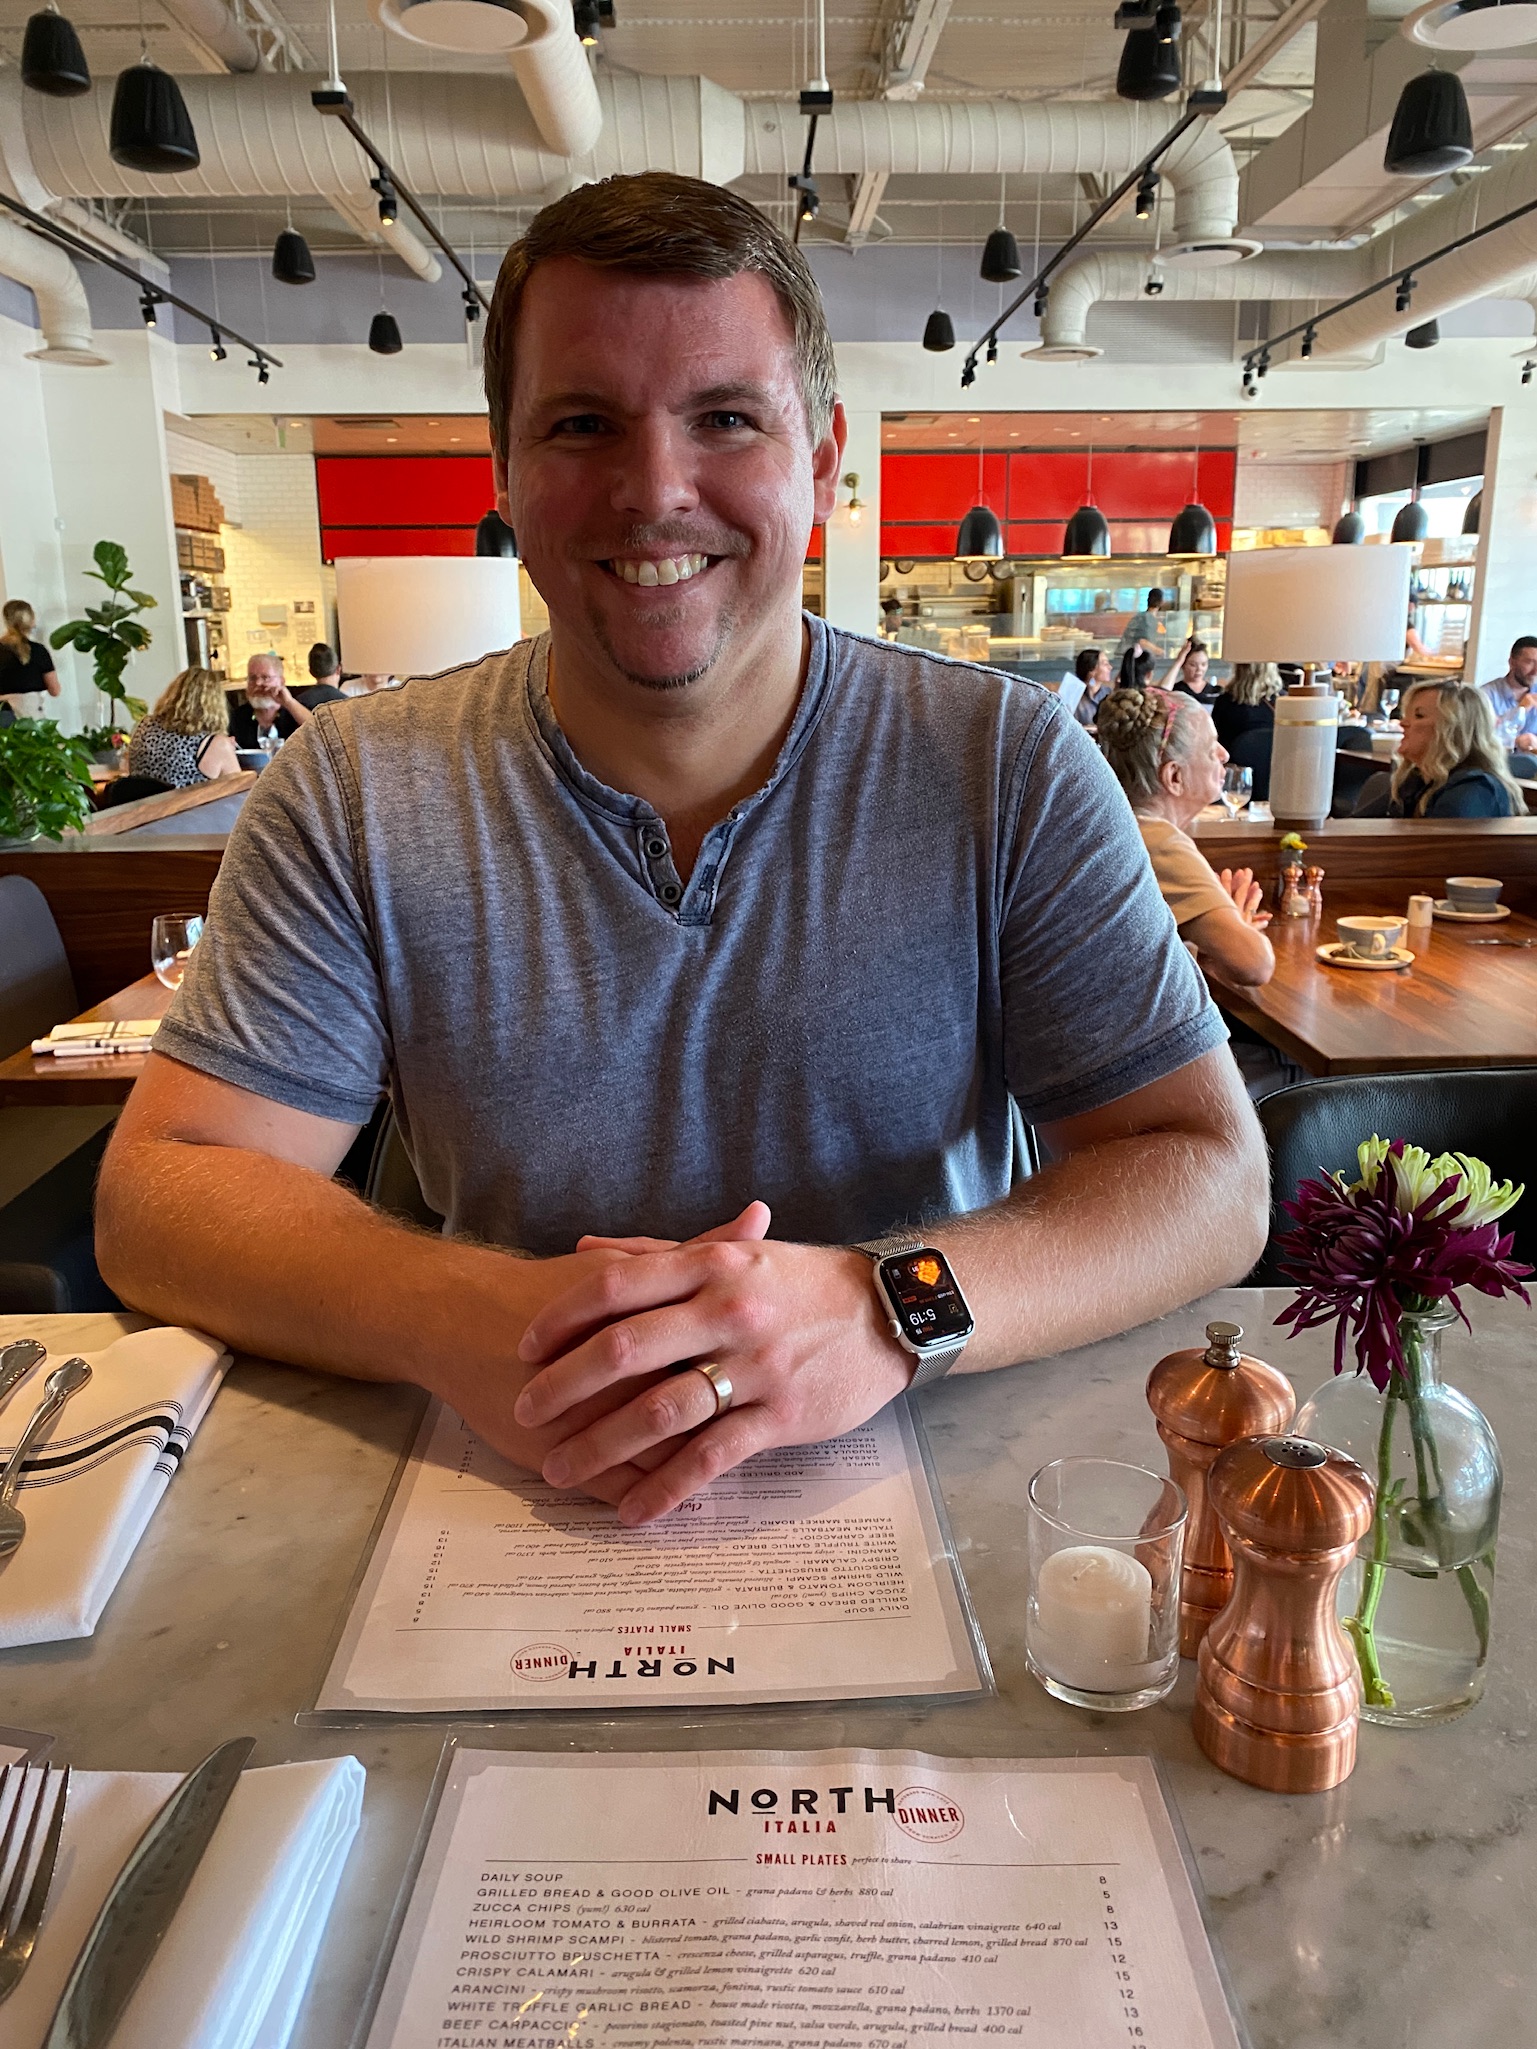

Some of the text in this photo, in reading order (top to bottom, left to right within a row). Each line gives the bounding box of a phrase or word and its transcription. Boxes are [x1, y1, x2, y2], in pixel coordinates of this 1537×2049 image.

[909, 1308, 937, 1326] 5:19
[793, 1526, 851, 1534] MEATBALLS
[862, 1555, 899, 1563] CRISPY
[759, 1564, 901, 1575] PROSCIUTTO BRUSCHETTA
[787, 1575, 826, 1583] SCAMPI
[832, 1573, 871, 1581] SHRIMP
[832, 1590, 864, 1598] CHIPS
[771, 1601, 803, 1609] GOOD
[820, 1599, 856, 1607] BREAD
[880, 1604, 909, 1612] DAILY
[617, 1624, 691, 1634] SMALL PLATES
[624, 1646, 684, 1656] ITALIA
[515, 1655, 568, 1670] DINNER
[568, 1657, 735, 1678] NORTH
[708, 1787, 896, 1815] NORTH
[898, 1807, 960, 1824] DINNER
[764, 1820, 836, 1833] ITALIA
[756, 1854, 797, 1865] SMALL
[802, 1854, 847, 1865] PLATES
[852, 1856, 879, 1865] perfect
[890, 1856, 911, 1864] share
[1100, 1876, 1106, 1884] 8
[477, 1888, 537, 1897] GRILLED
[543, 1889, 590, 1897] BREAD
[611, 1889, 653, 1897] GOOD
[660, 1888, 700, 1897] OLIVE
[776, 1888, 812, 1897] padano
[880, 1888, 893, 1896] cal
[1103, 1890, 1110, 1898] 5
[473, 1903, 520, 1912] ZUCCA
[527, 1904, 570, 1912] CHIPS
[577, 1905, 609, 1915] (yum!)
[636, 1904, 651, 1912] cal
[1107, 1905, 1114, 1913] 8
[469, 1919, 545, 1928] HEIRLOOM
[553, 1919, 610, 1928] TOMATO
[617, 1920, 624, 1928] &
[632, 1919, 695, 1928] BURRATA
[713, 1916, 744, 1928] grilled
[747, 1917, 787, 1926] ciabatta,
[791, 1918, 830, 1928] arugula,
[836, 1918, 867, 1926] shaved
[870, 1919, 884, 1927] red
[920, 1921, 963, 1929] calabrian
[967, 1924, 1019, 1933] vinaigrette
[1048, 1922, 1061, 1930] cal
[1104, 1921, 1118, 1930] 13
[466, 1935, 500, 1943] WILD
[506, 1935, 563, 1943] SHRIMP
[569, 1936, 623, 1944] SCAMPI
[642, 1935, 682, 1944] blistered
[684, 1934, 719, 1943] tomato,
[722, 1933, 750, 1944] grana
[752, 1932, 791, 1943] padano,
[794, 1933, 821, 1944] garlic
[824, 1934, 852, 1945] confit,
[880, 1935, 909, 1944] butter,
[913, 1936, 948, 1945] charred
[952, 1938, 982, 1947] lemon,
[987, 1938, 1017, 1949] grilled
[1020, 1938, 1047, 1946] bread
[1108, 1937, 1122, 1946] 15
[460, 1951, 555, 1960] PROSCIUTTO
[562, 1952, 659, 1960] BRUSCHETTA
[726, 1948, 755, 1957] cheese,
[759, 1949, 792, 1959] grilled
[795, 1952, 846, 1962] asparagus,
[850, 1951, 883, 1963] truffle,
[886, 1954, 916, 1964] grana
[919, 1954, 956, 1964] padano
[1112, 1954, 1126, 1963] 12
[456, 1965, 1130, 1980] CRISPY CALAMARI arugula & grilled lemon vinaigrette 620 cal 15
[452, 1984, 524, 1994] ARANCINI
[576, 1986, 626, 1995] mushroom
[720, 1981, 762, 1993] fontina,
[868, 1986, 888, 1994] 610
[890, 1986, 904, 1994] cal
[1120, 1989, 1134, 1999] 12
[448, 2002, 494, 2011] WHITE
[576, 2002, 632, 2012] GARLIC
[640, 2000, 690, 2011] BREAD
[710, 2000, 737, 2008] house
[741, 2000, 768, 2008] made
[772, 2002, 807, 2010] ricotta,
[812, 2001, 872, 2012] mozzarella,
[876, 2005, 906, 2016] grana
[909, 2004, 950, 2017] padano,
[954, 2005, 980, 2015] herbs
[988, 2006, 1013, 2016] 1370
[1016, 2006, 1030, 2016] cal
[1124, 2007, 1139, 2018] 13
[442, 2019, 481, 2029] BEEF
[1128, 2026, 1143, 2037] 16
[438, 2038, 593, 2048] ITALIAN MEATBALLS
